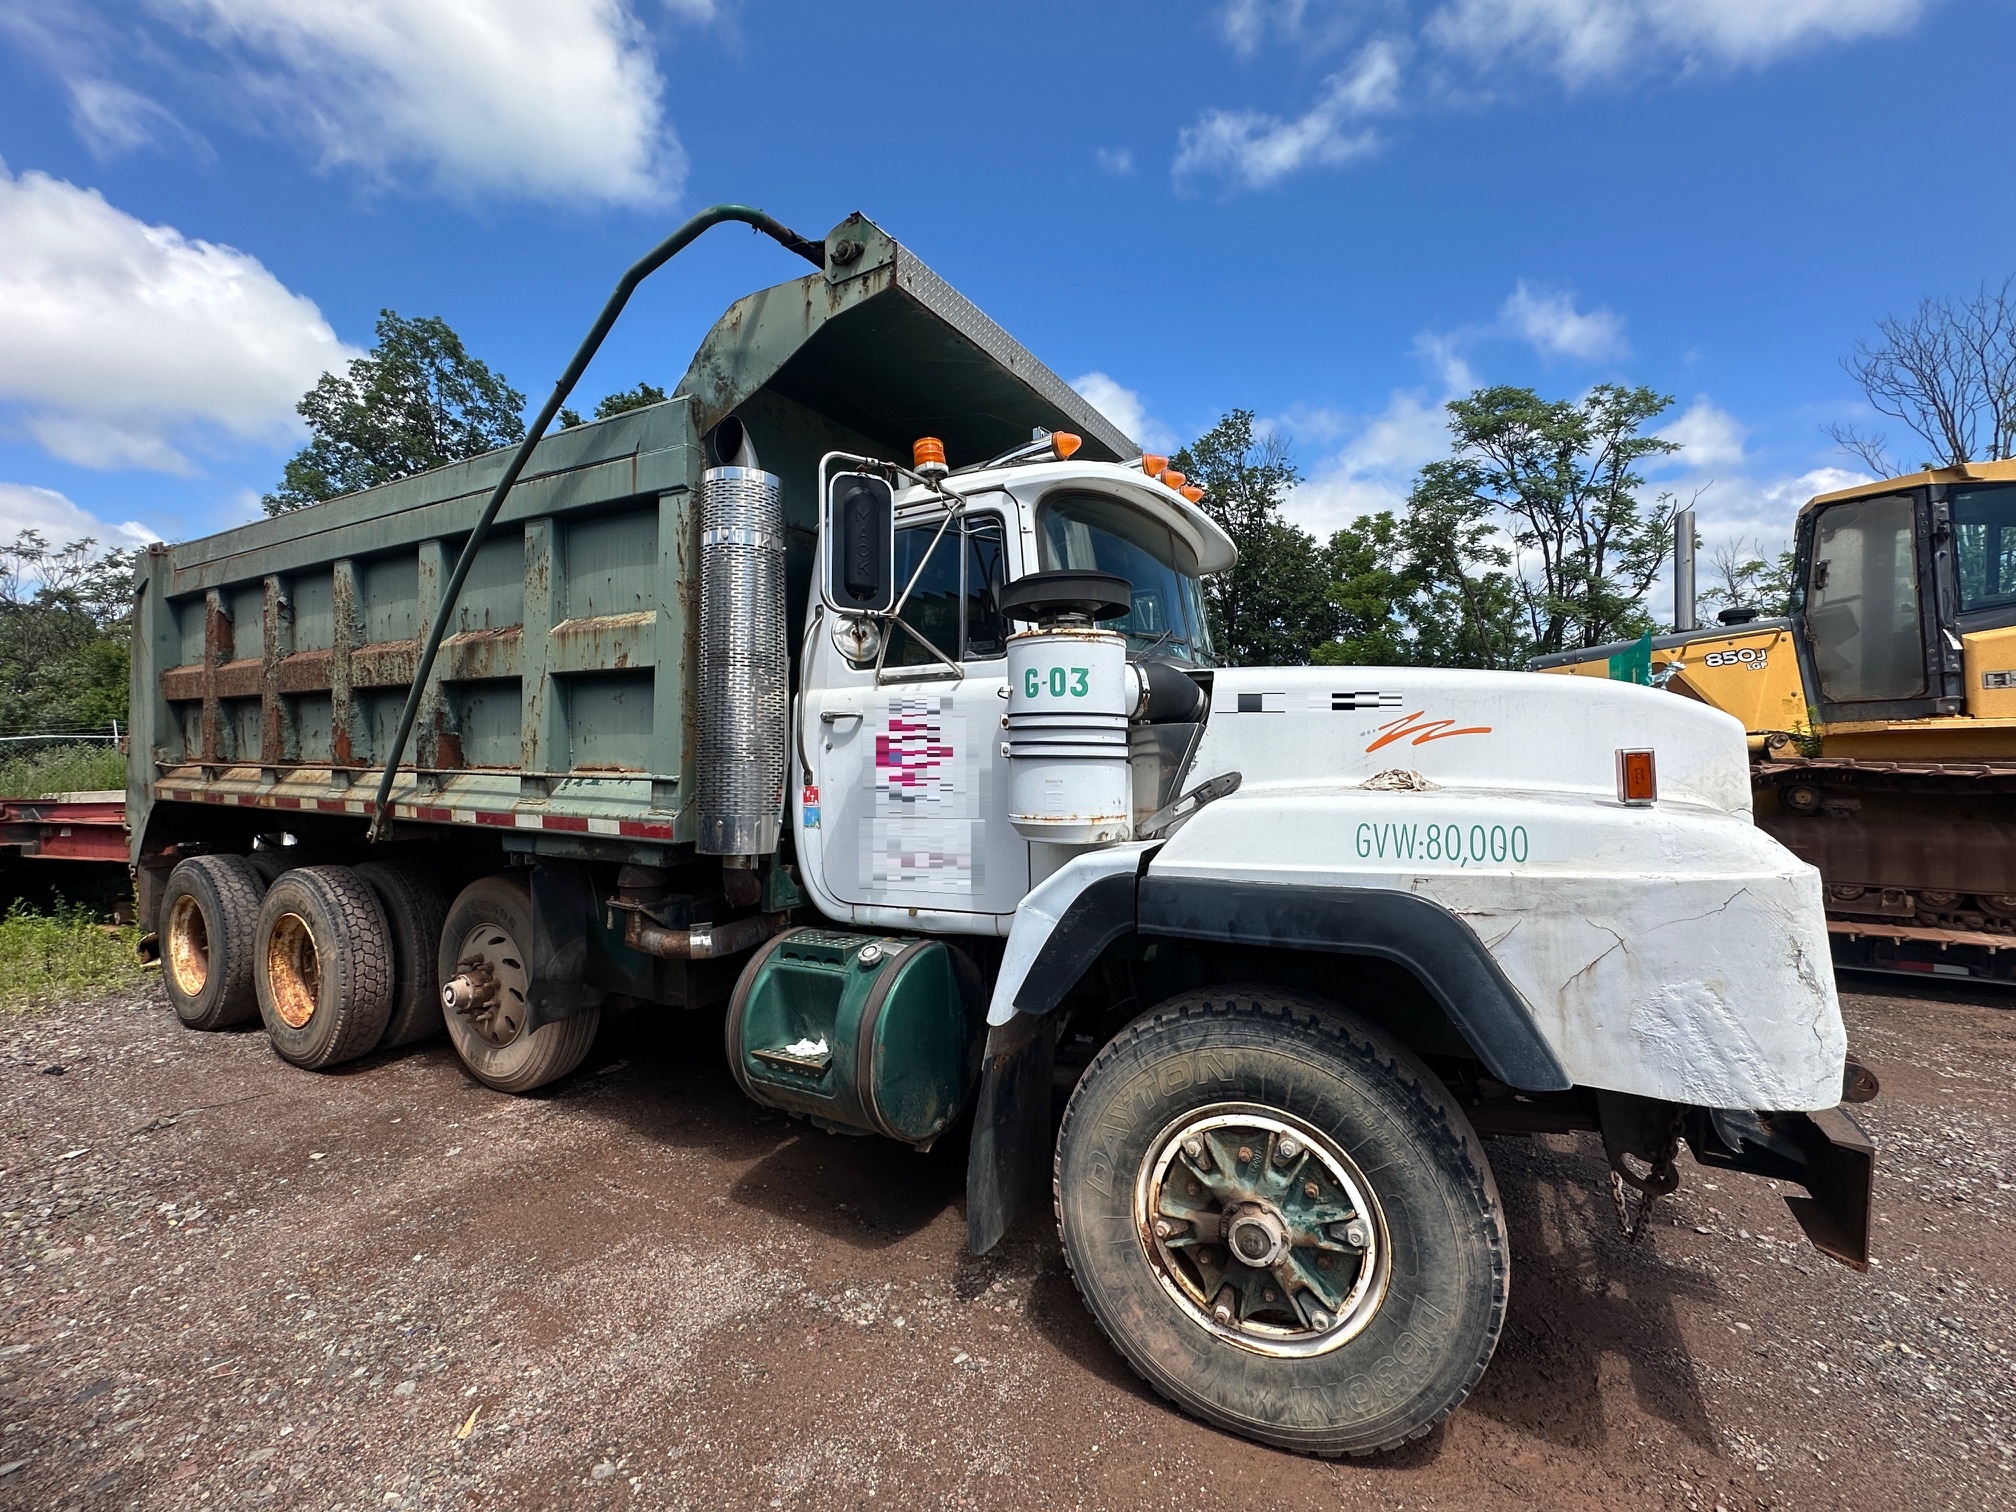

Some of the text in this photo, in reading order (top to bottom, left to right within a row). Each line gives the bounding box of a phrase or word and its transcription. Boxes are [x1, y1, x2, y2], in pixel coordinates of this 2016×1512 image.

[855, 507, 870, 577] MACK
[1704, 648, 1768, 667] 850J
[1746, 660, 1769, 671] LGP
[1024, 667, 1090, 698] G-03
[1355, 822, 1529, 868] GVW:80,000
[1085, 1051, 1236, 1199] DAYTON
